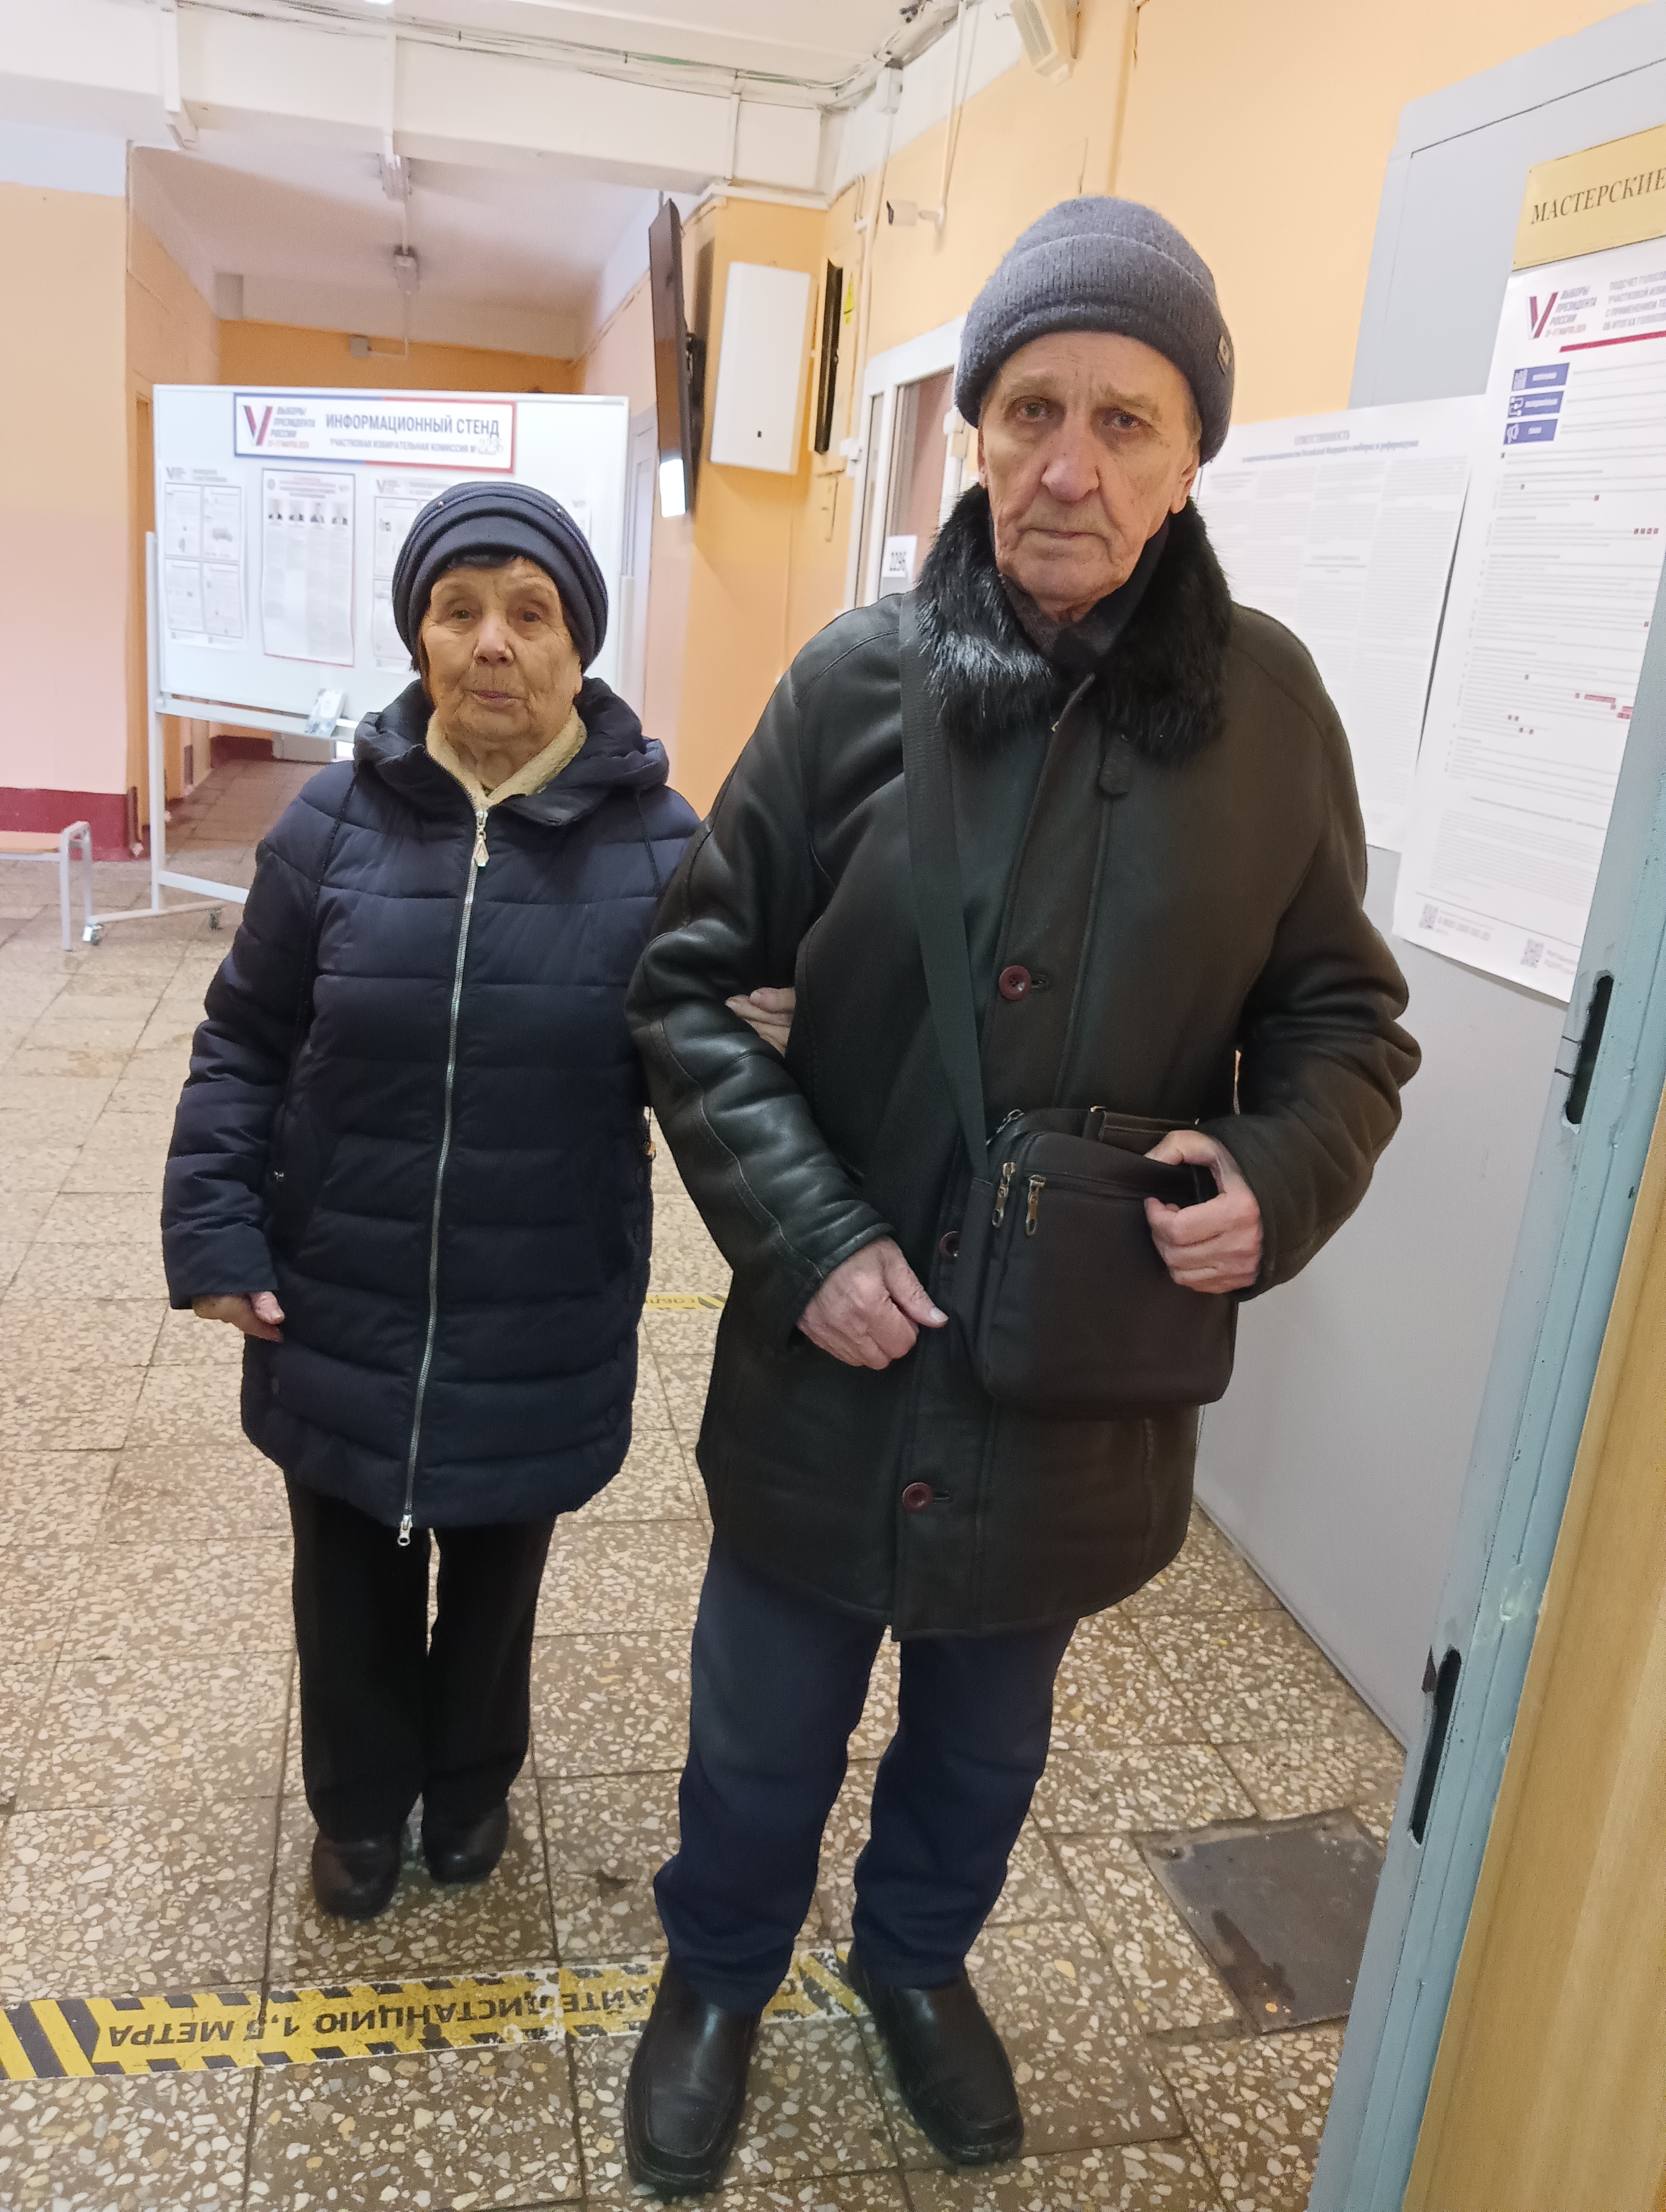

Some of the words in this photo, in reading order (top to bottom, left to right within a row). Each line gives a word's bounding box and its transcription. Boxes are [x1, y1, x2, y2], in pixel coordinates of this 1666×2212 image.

[1530, 168, 1666, 224] МАСТЕРСКИЕ
[325, 413, 453, 434] ИНФОРМАЦИОННЫЙ
[457, 418, 500, 438] СТЕНД
[110, 2021, 235, 2047] МЕТРА
